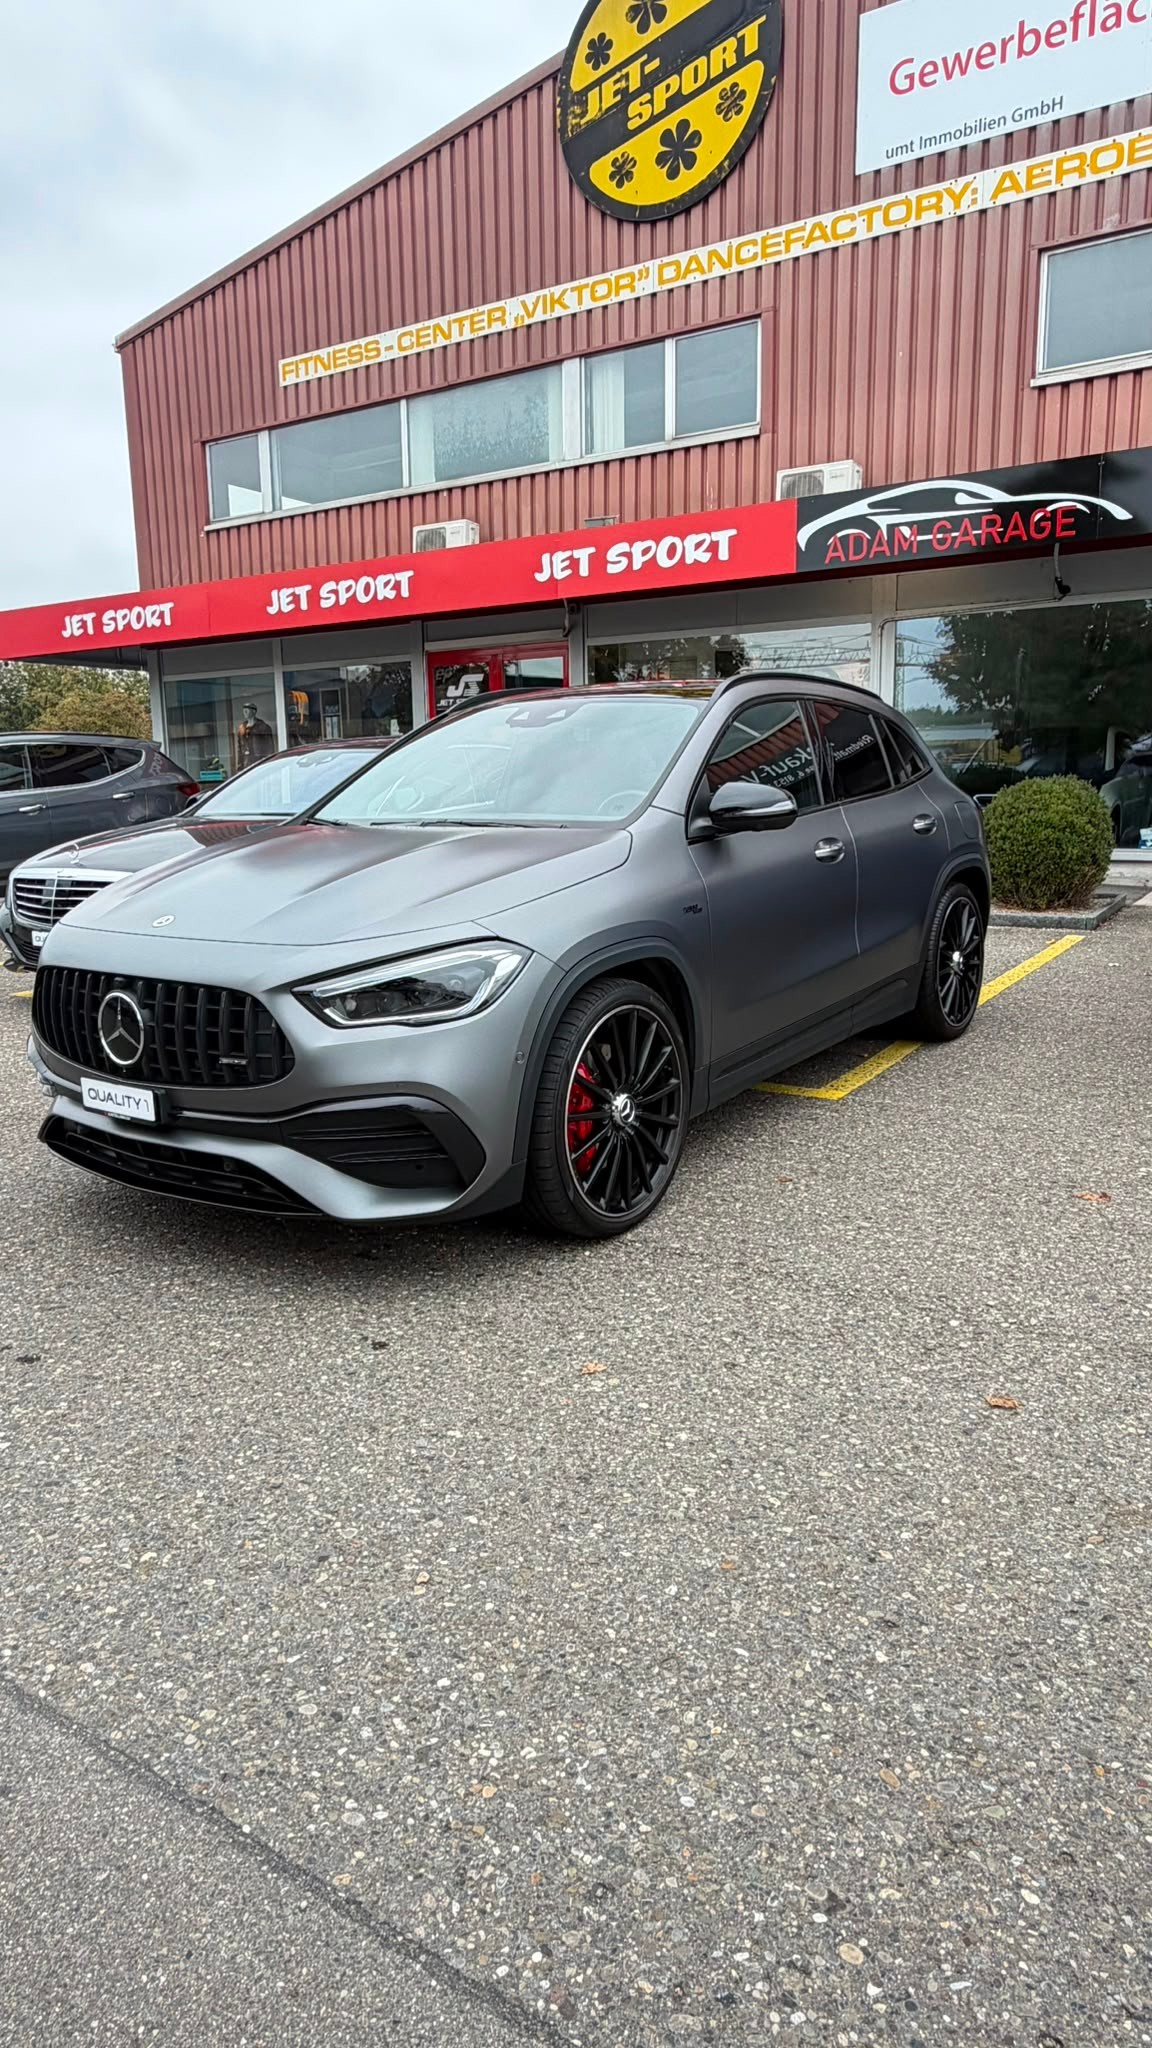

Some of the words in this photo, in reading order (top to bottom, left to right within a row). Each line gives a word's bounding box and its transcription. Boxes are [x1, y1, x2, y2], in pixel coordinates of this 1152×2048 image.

[627, 15, 767, 131] SPORT
[888, 0, 1152, 95] Gewerbefläc
[885, 140, 915, 160] umt
[918, 116, 1007, 151] Immobilien
[1011, 95, 1064, 124] GmbH
[657, 180, 979, 286] DANCEFACTORY:
[533, 547, 597, 582] JET
[606, 528, 738, 575] SPORT
[824, 524, 918, 565] ADAM
[930, 505, 1078, 552] GARAGE
[61, 612, 97, 638] JET
[101, 602, 175, 634] SPORT
[266, 584, 313, 615] JET
[319, 570, 415, 609] SPORT
[87, 1087, 142, 1110] QUALITY
[144, 1099, 150, 1112] 1
